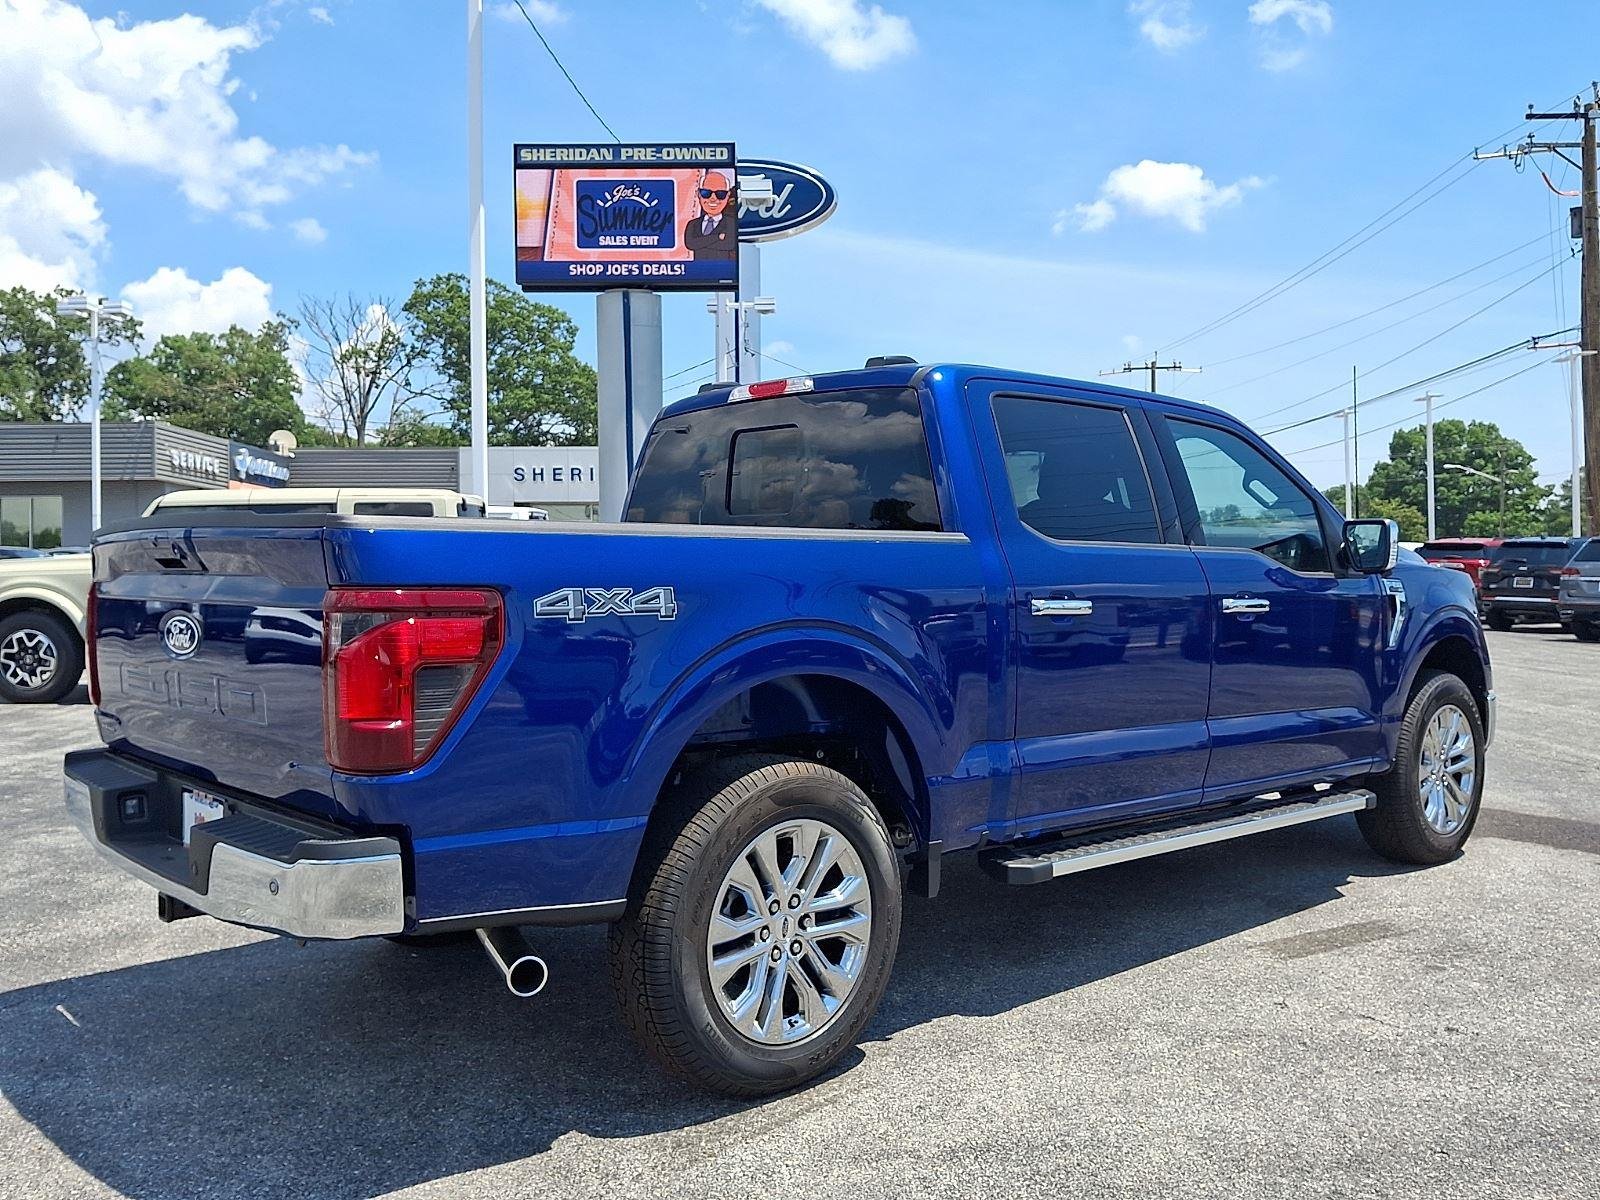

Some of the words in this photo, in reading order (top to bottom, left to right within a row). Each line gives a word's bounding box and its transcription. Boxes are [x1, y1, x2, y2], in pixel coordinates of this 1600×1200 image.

[520, 148, 613, 161] SHERIDAN
[620, 147, 729, 160] PRE-OWNED
[612, 184, 641, 203] Joe's
[578, 194, 675, 238] Summer
[598, 235, 628, 246] SALES
[629, 235, 659, 246] EVENT
[569, 263, 604, 276] SHOP
[606, 263, 639, 276] JOE'S
[642, 263, 686, 276] DEALS!
[170, 449, 221, 475] SERVICE
[168, 621, 192, 648] Ford
